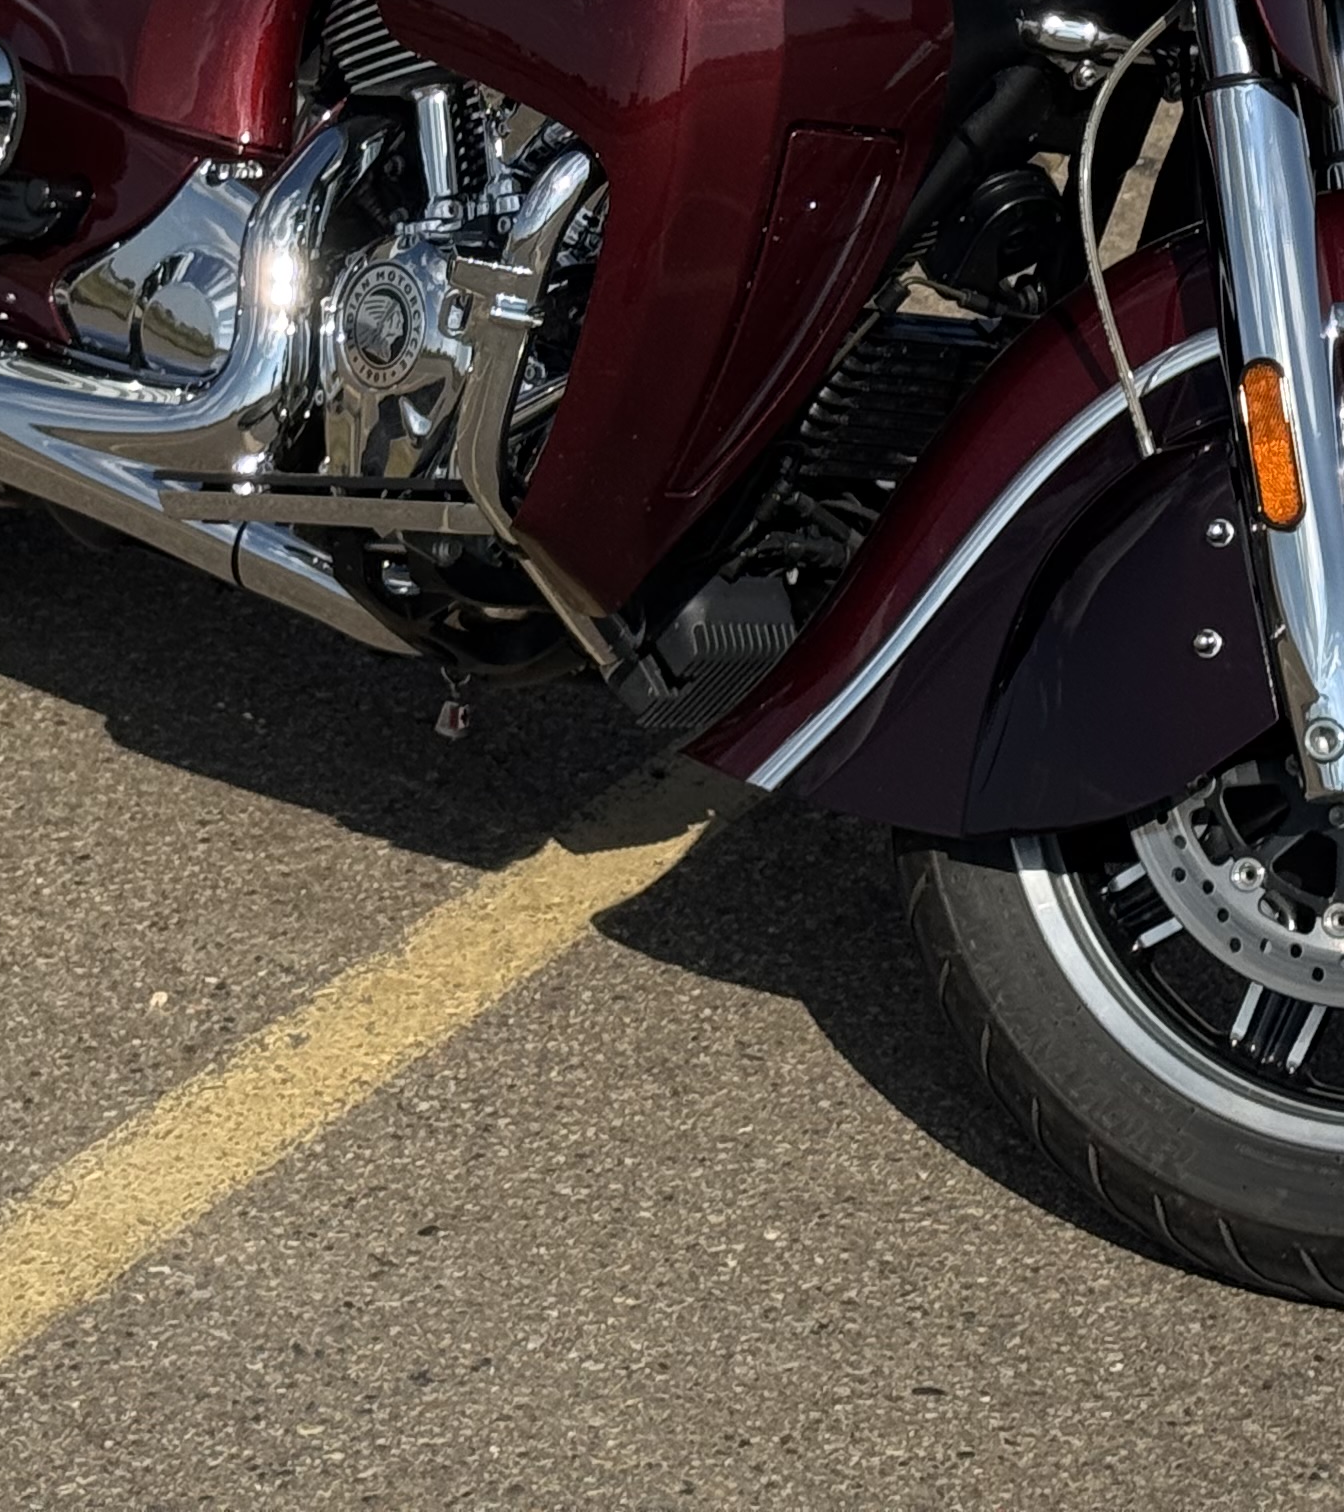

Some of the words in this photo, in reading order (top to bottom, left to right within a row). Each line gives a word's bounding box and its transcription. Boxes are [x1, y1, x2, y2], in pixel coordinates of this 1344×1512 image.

[346, 279, 370, 352] INDIAN
[376, 270, 421, 370] MOTORCYCLE
[359, 365, 387, 382] 1901
